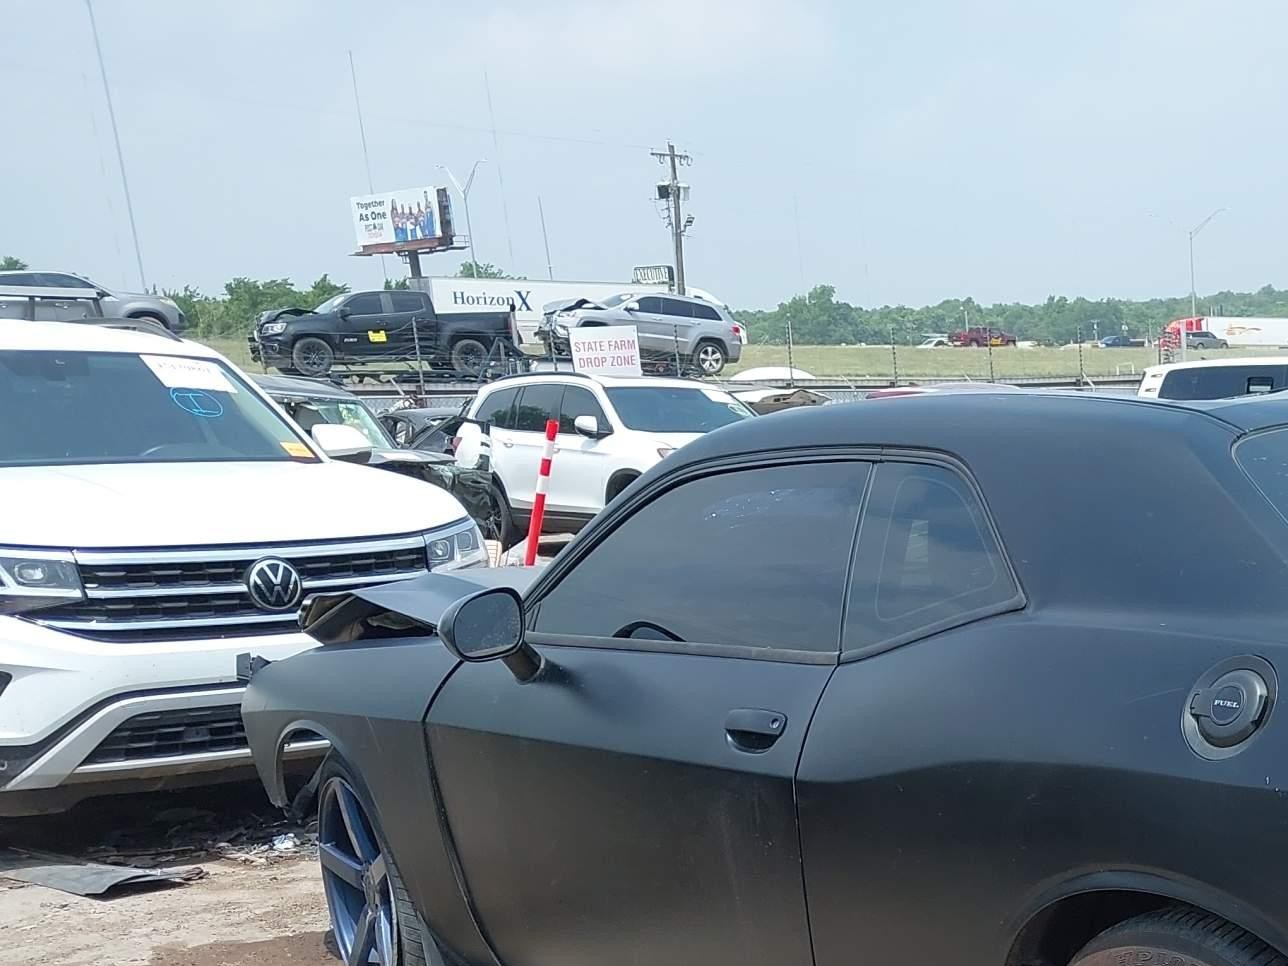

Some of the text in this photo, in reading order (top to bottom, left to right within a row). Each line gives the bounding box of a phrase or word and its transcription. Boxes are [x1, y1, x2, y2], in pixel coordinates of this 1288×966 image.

[356, 199, 385, 211] Together
[359, 211, 387, 222] As One
[574, 339, 636, 353] STATE FARM
[579, 355, 636, 369] DROP ZONE
[1213, 699, 1240, 709] FUEL
